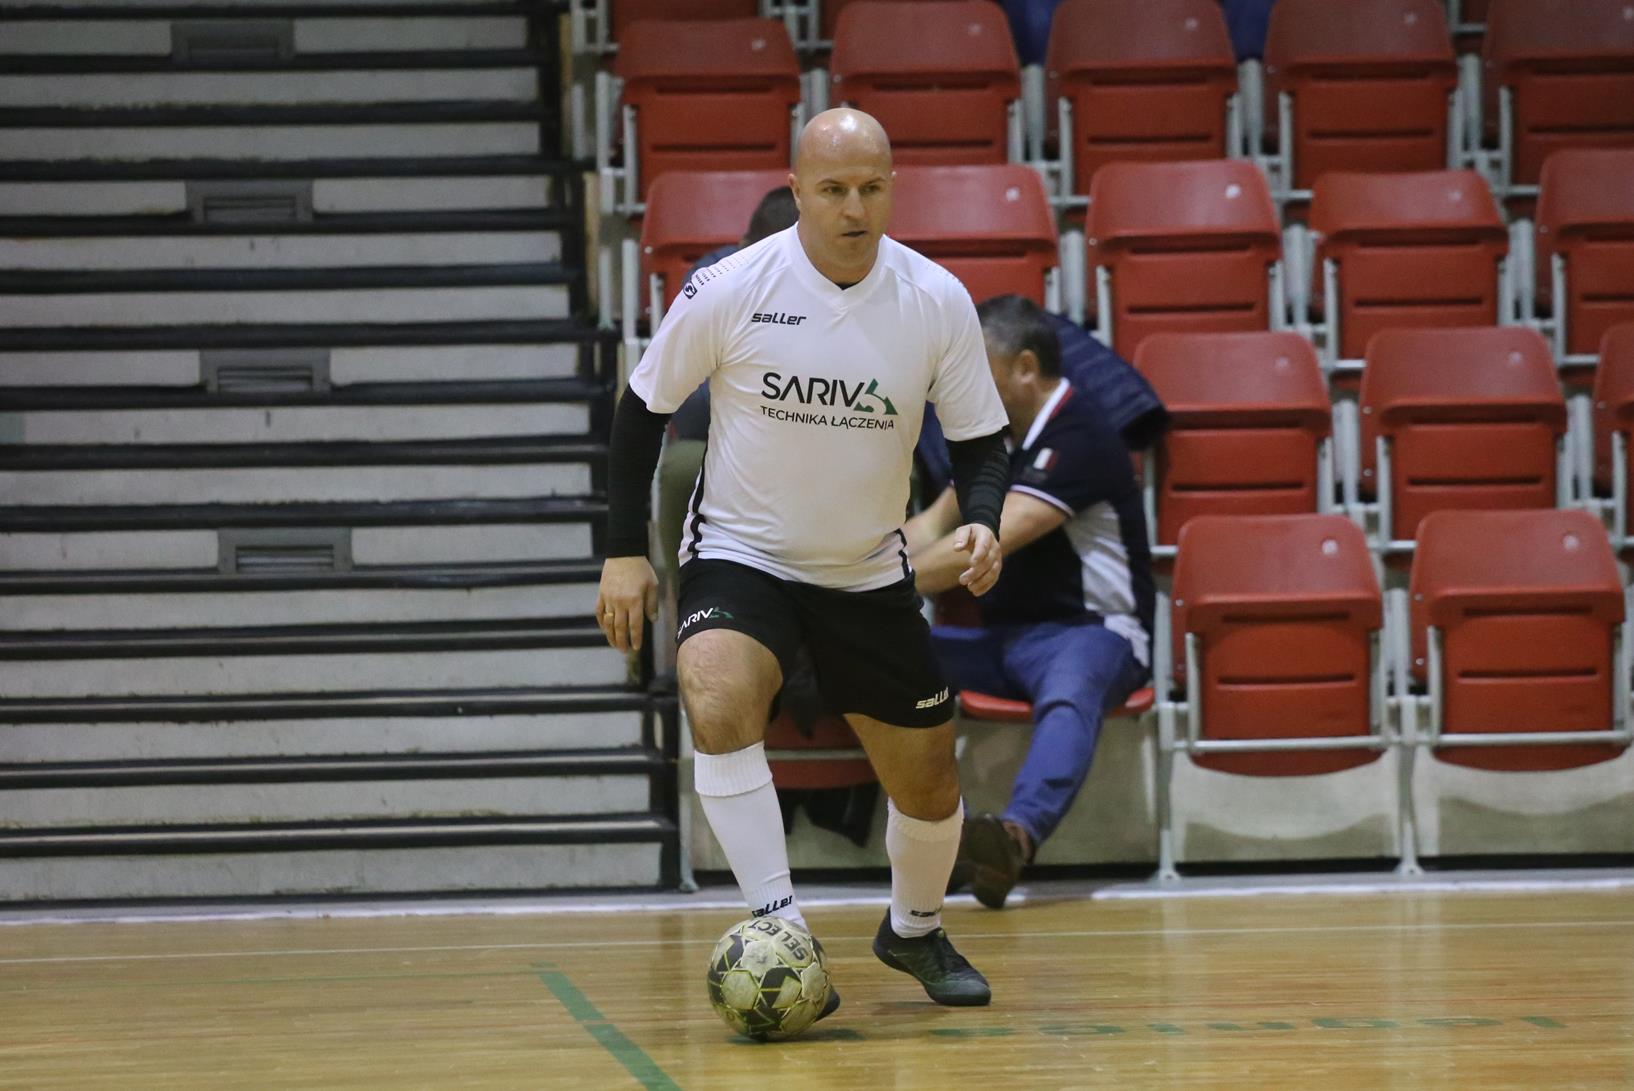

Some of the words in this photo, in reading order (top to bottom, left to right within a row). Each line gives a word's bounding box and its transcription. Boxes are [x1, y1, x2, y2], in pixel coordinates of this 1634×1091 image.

[751, 312, 807, 325] saller
[760, 405, 828, 426] TECHNIKA
[831, 415, 895, 430] ŁĄCZENIA
[748, 920, 809, 961] SELECT
